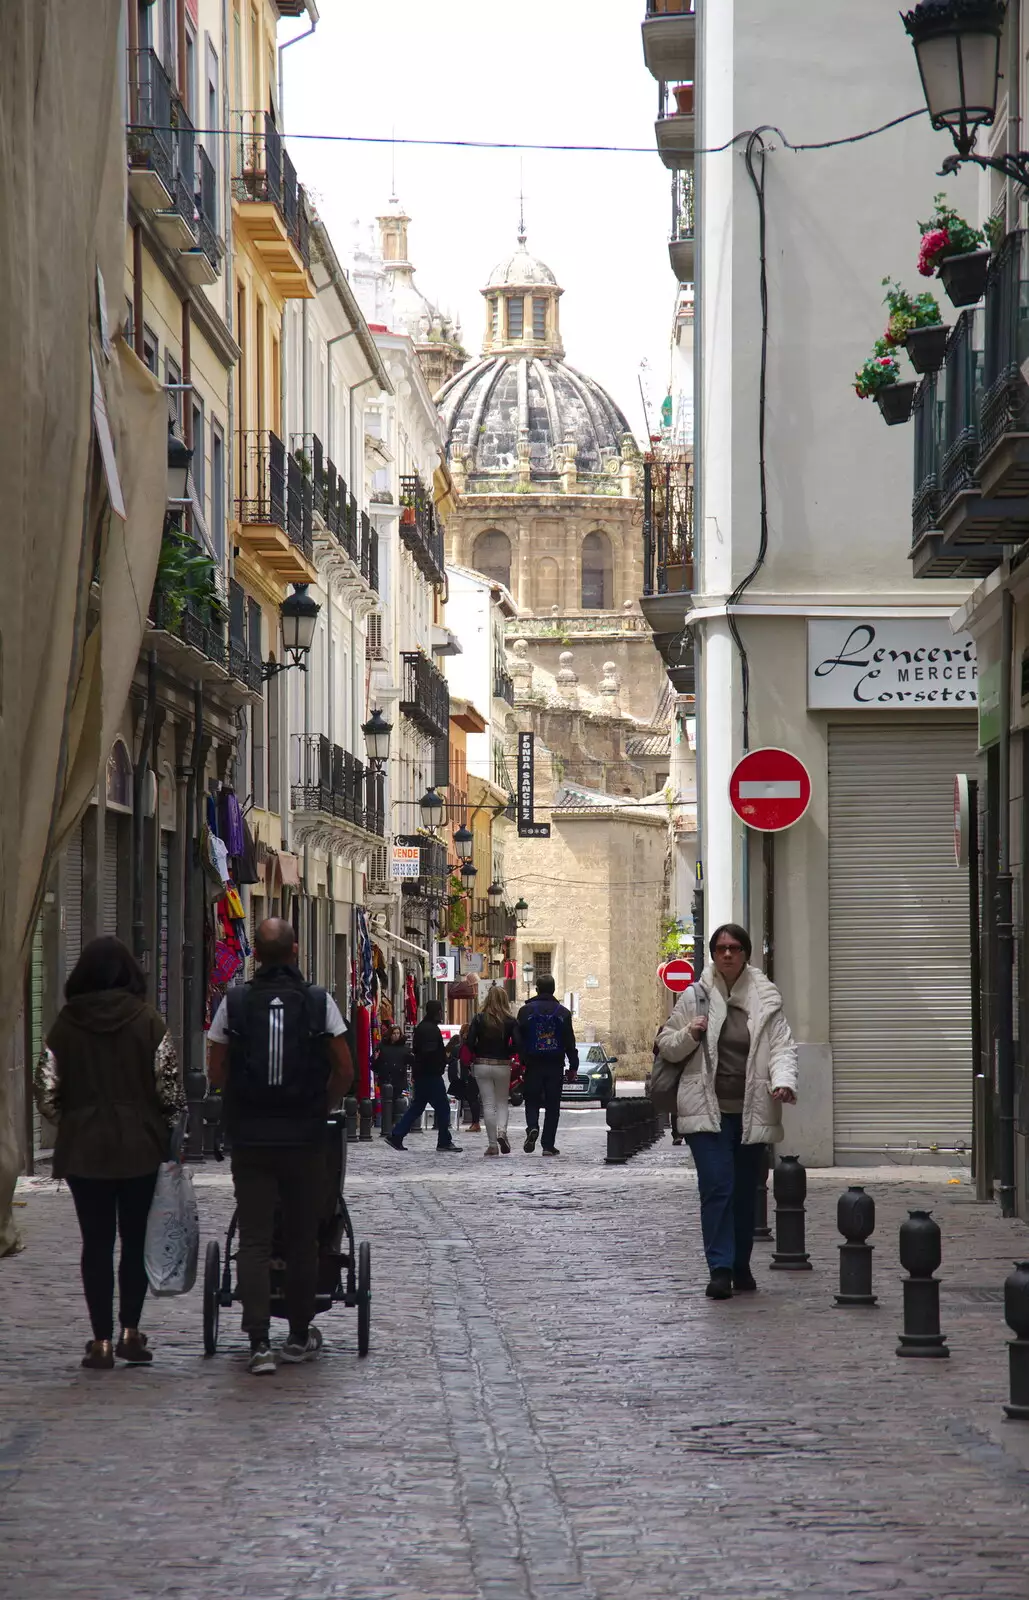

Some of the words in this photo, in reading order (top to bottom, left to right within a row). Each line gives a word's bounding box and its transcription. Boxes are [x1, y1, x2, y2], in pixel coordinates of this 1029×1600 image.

[814, 624, 978, 677] Lencerí
[522, 735, 531, 769] FONDA
[522, 772, 531, 820] SANCHEZ
[393, 848, 419, 858] VENDE
